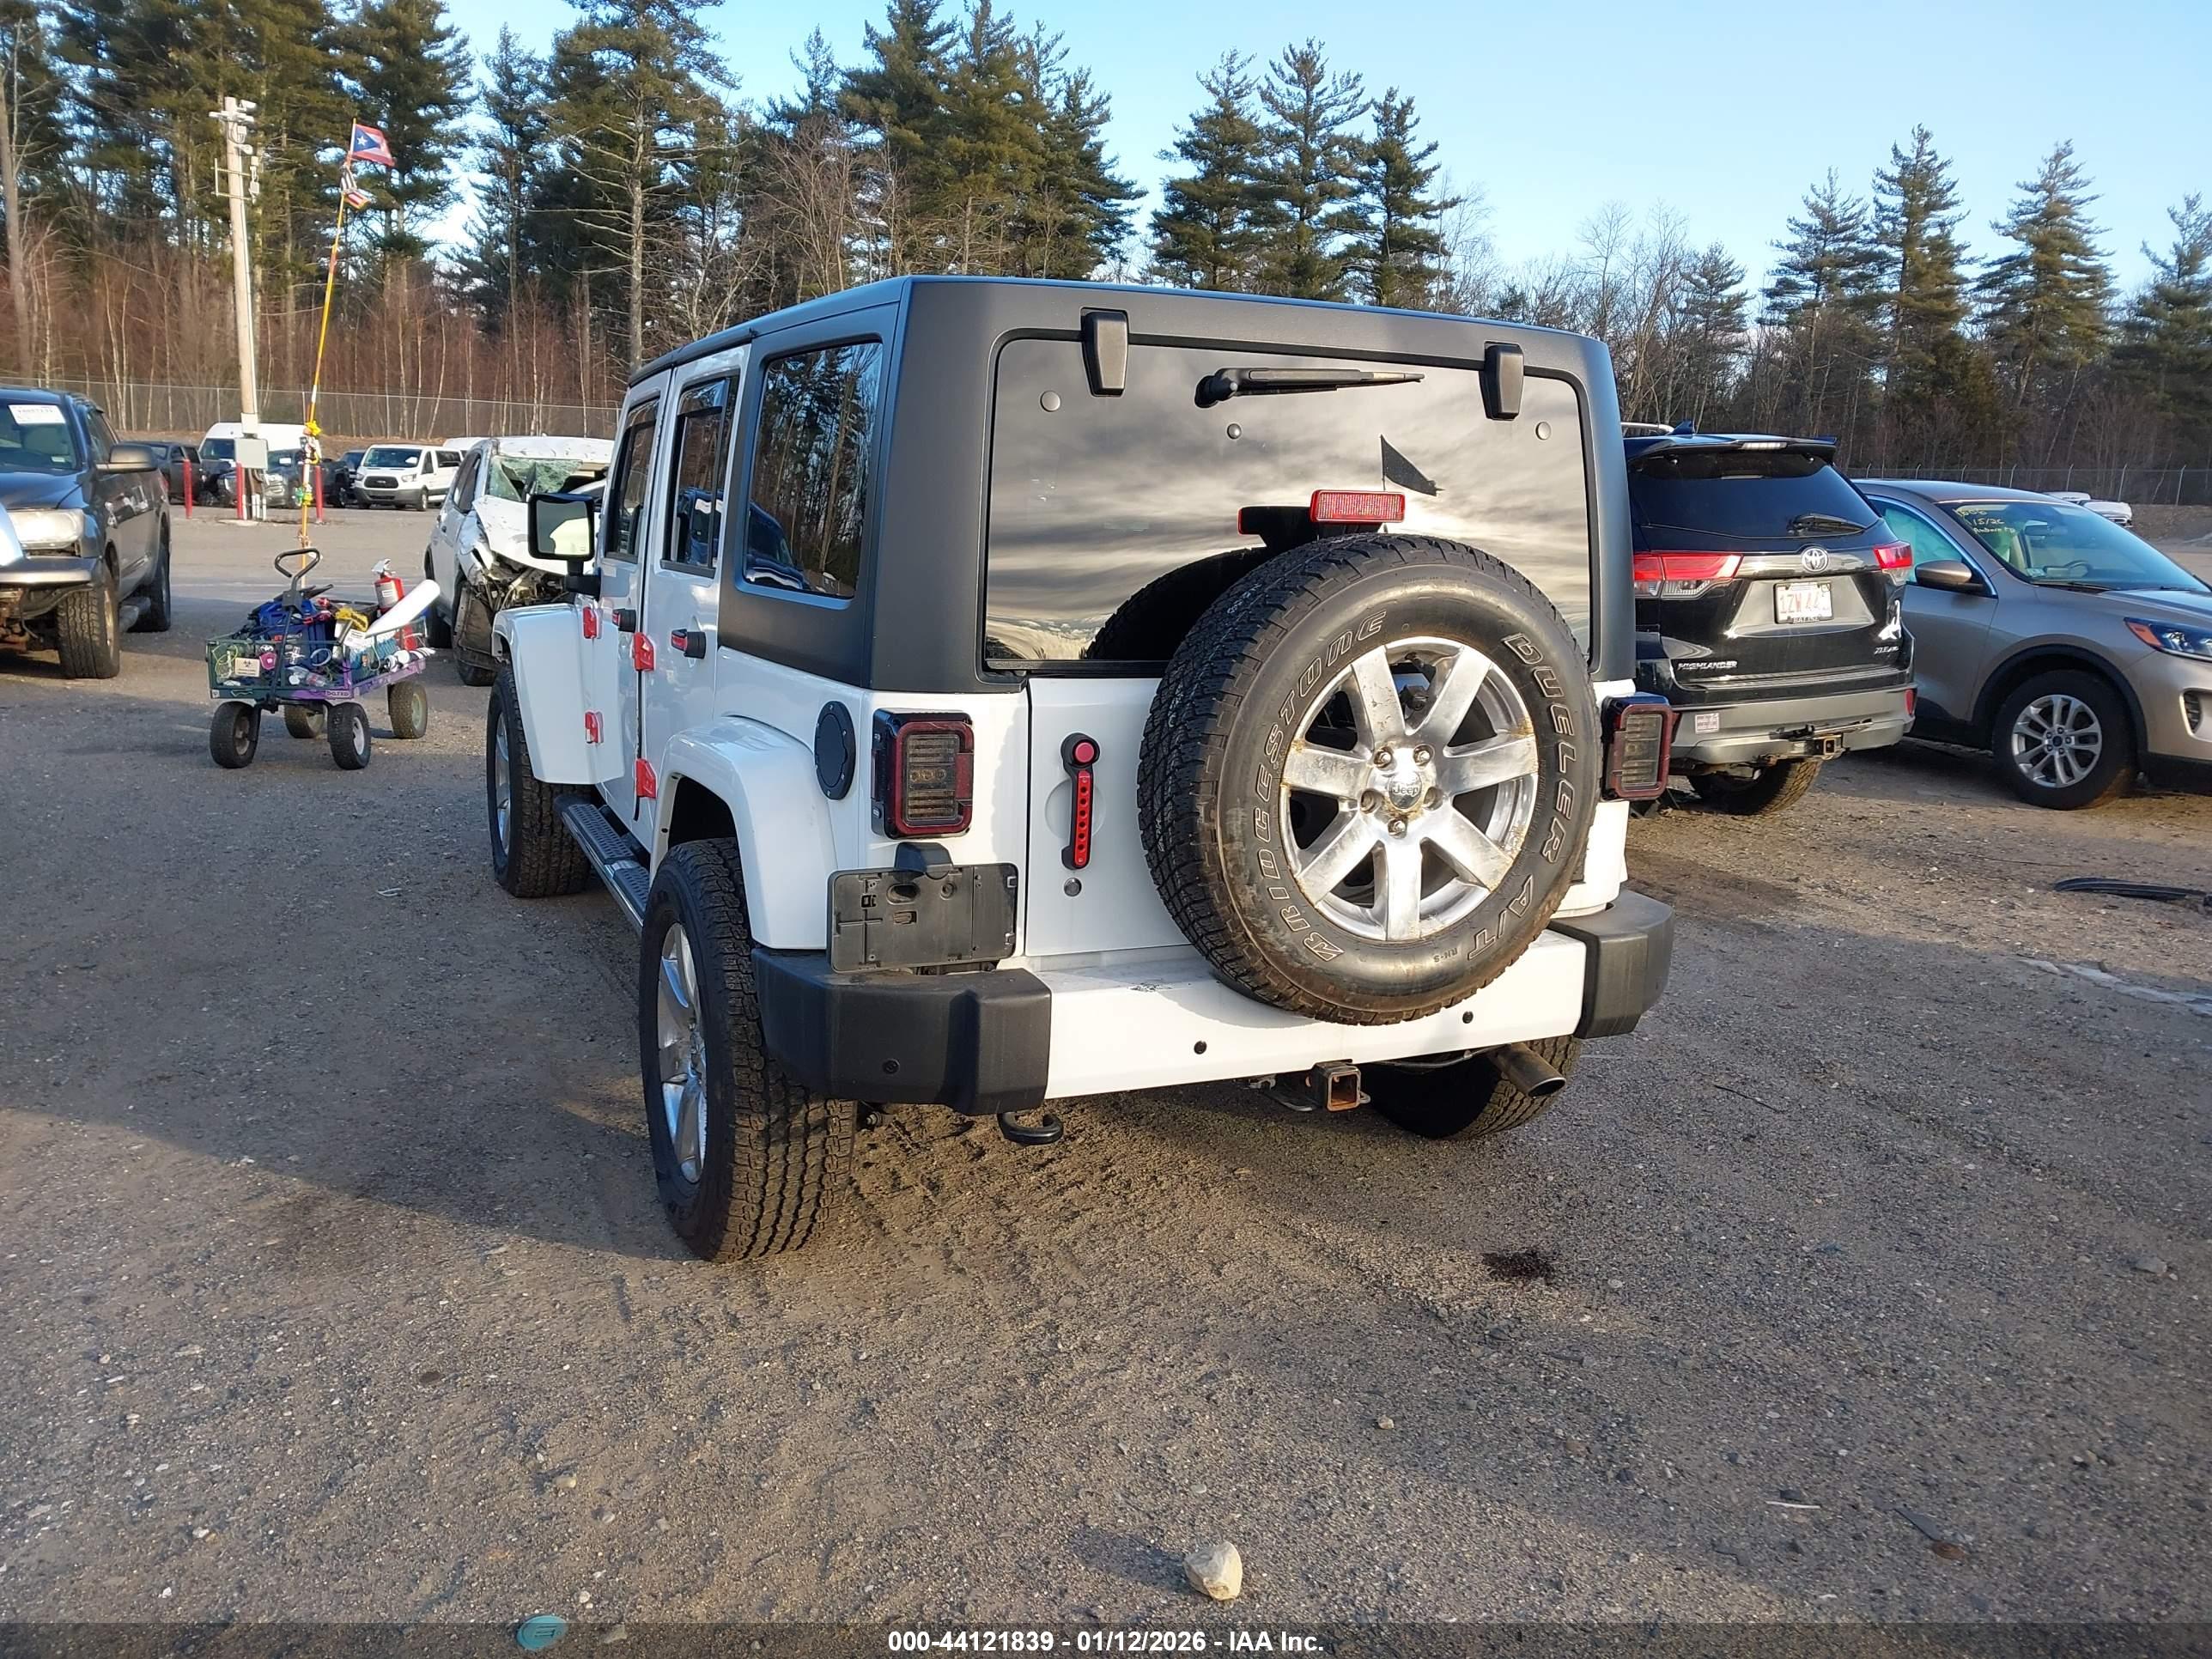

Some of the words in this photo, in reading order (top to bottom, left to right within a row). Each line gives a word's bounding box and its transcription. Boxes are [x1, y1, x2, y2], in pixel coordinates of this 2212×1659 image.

[1677, 660, 1738, 671] HIGHLANDER
[1255, 611, 1386, 961] BRIDGESTONE
[1393, 783, 1419, 796] Jeep
[1502, 632, 1576, 864] DUELER
[1467, 874, 1534, 960] A/T
